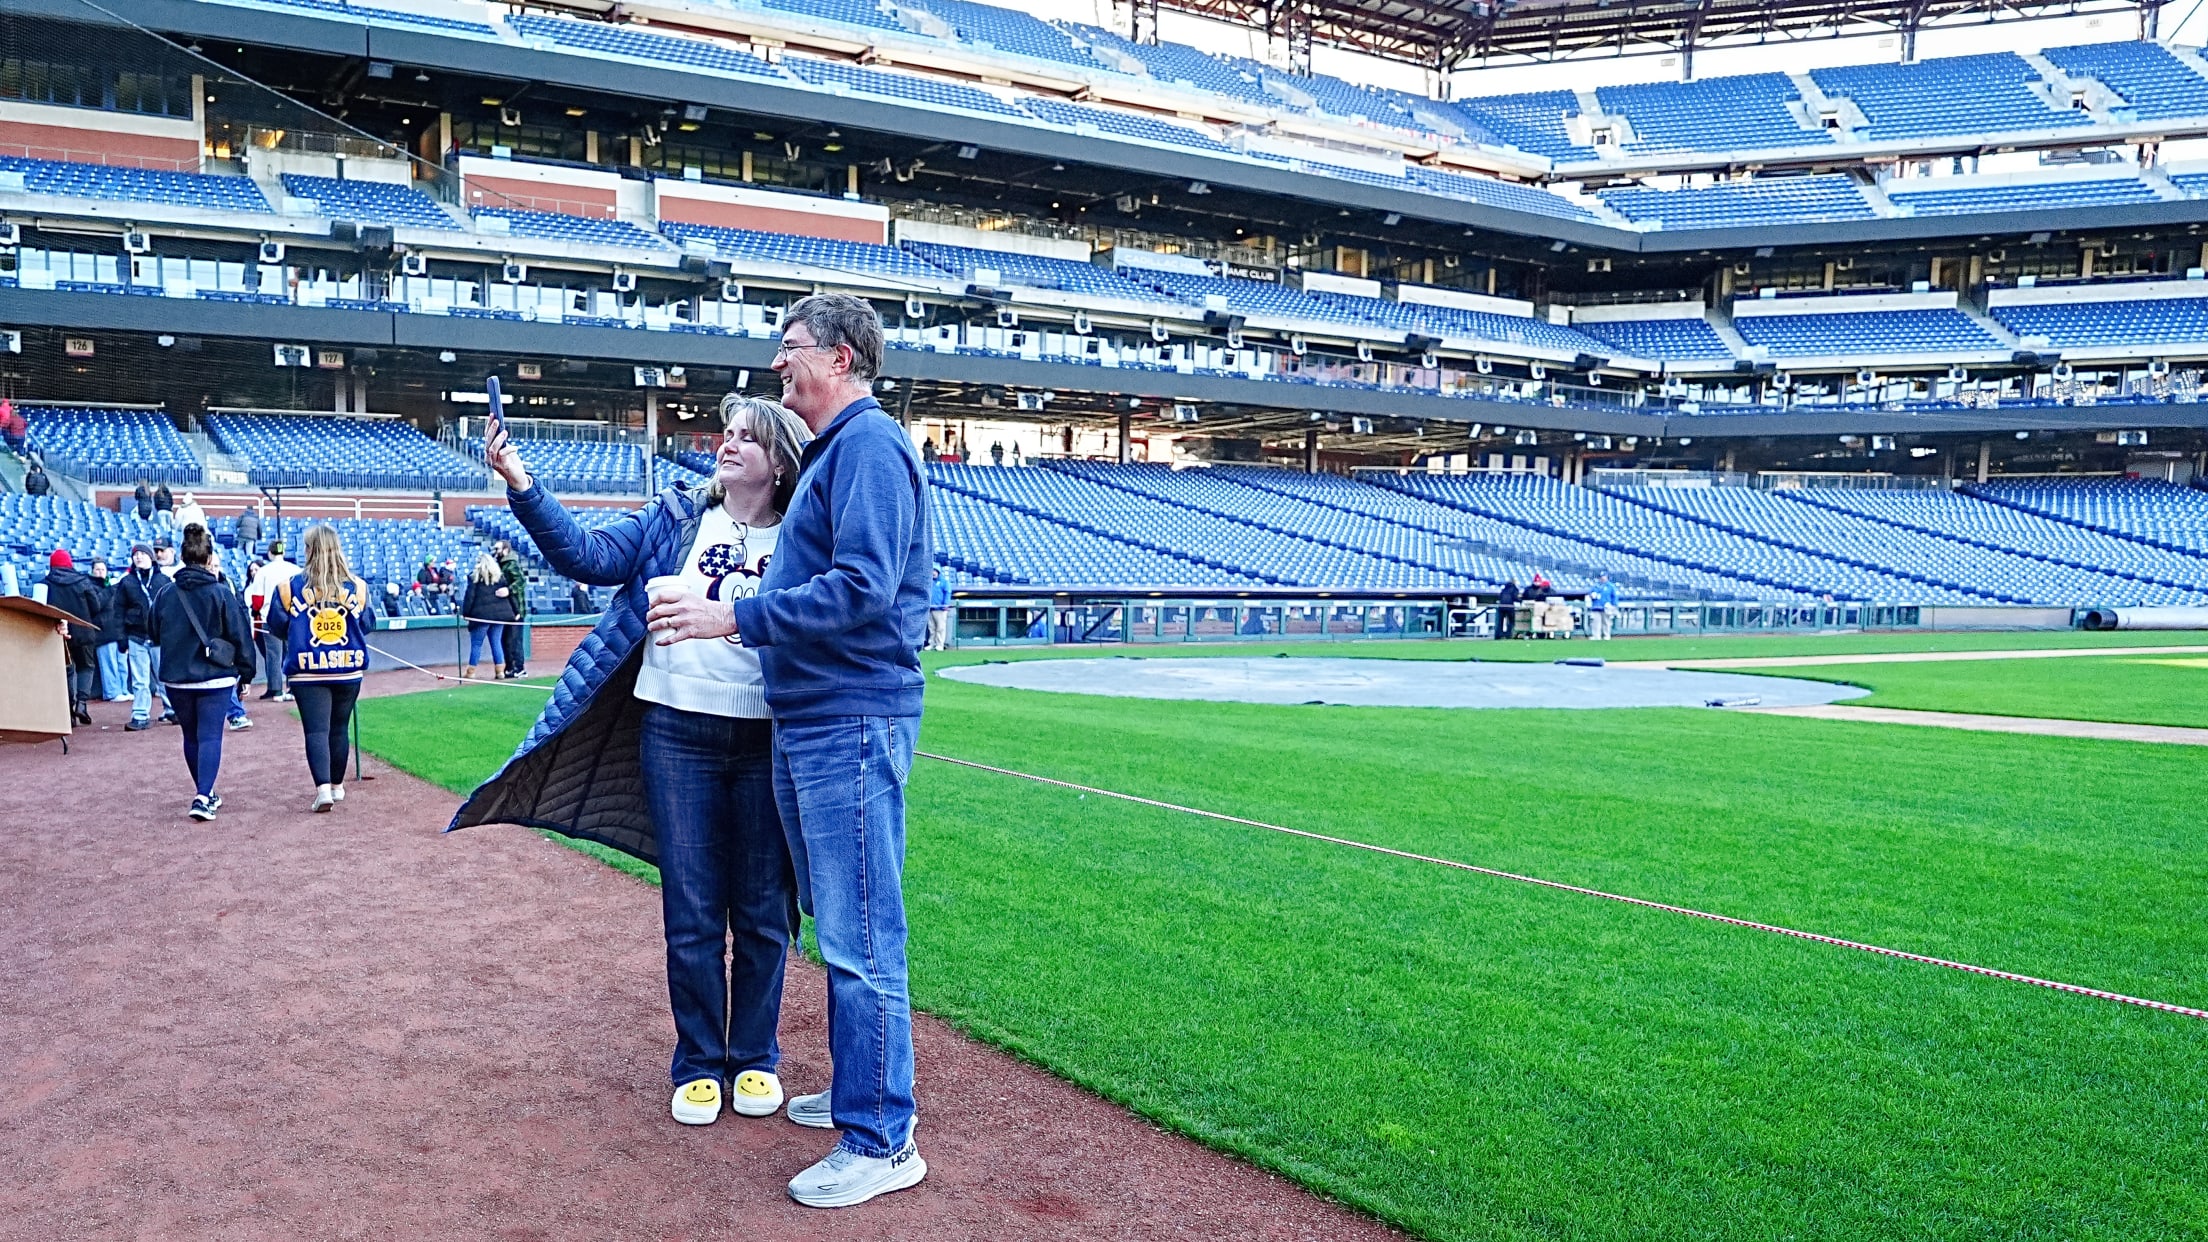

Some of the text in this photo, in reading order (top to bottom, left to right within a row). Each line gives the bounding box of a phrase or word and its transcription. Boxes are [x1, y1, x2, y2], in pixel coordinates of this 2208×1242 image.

[1223, 267, 1248, 278] AME
[1249, 270, 1275, 281] CLUB
[72, 340, 87, 351] 126
[324, 353, 337, 364] 127
[316, 621, 342, 631] 2026
[298, 649, 365, 670] FLASHES
[891, 1142, 916, 1169] HOKA
